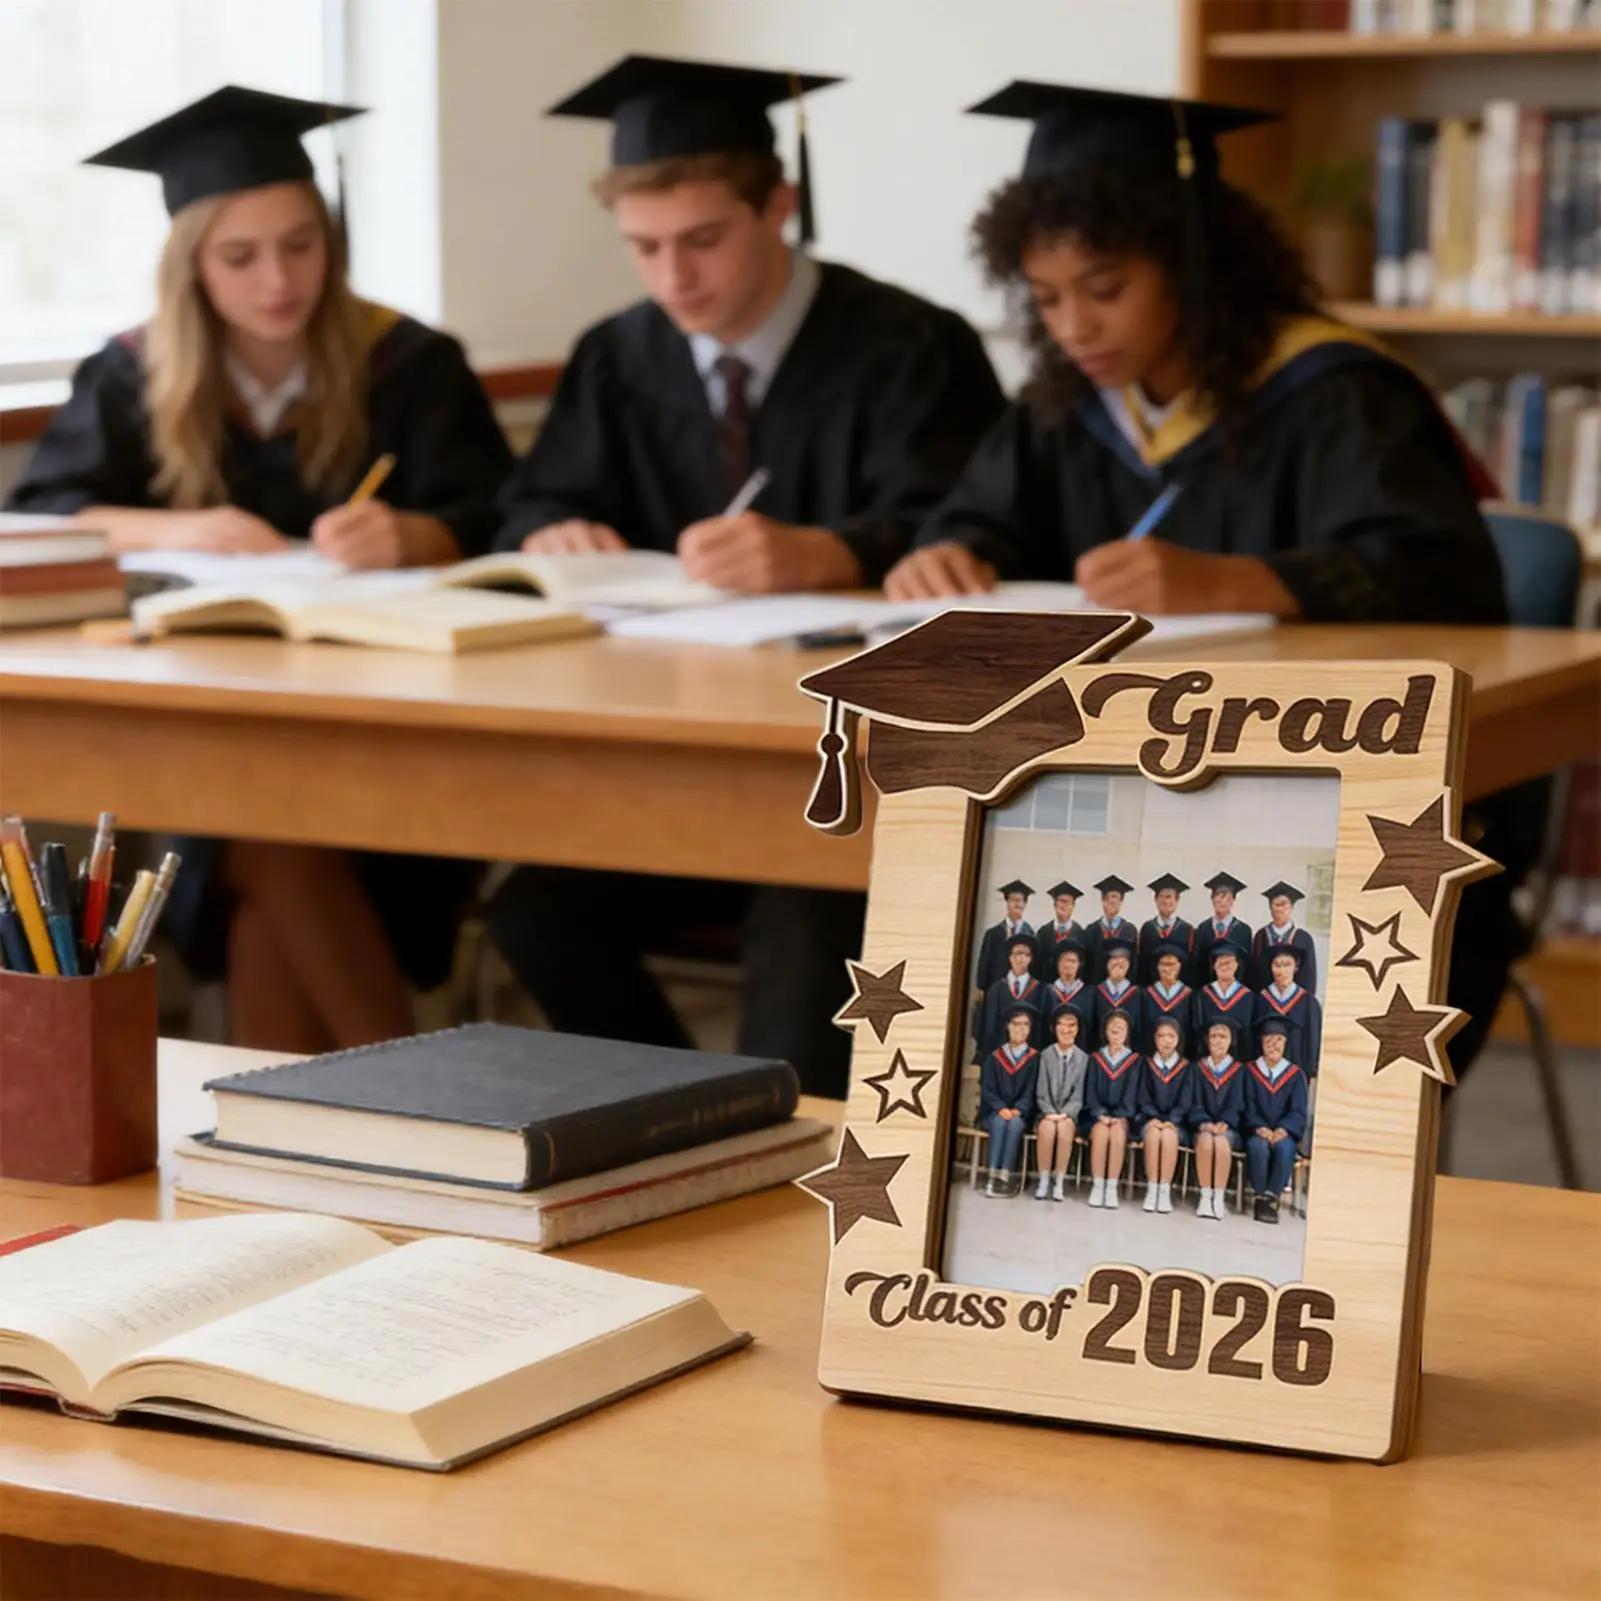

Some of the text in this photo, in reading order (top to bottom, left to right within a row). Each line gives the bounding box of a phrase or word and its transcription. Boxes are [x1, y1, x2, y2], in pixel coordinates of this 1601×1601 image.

[1081, 671, 1435, 776] Grad
[845, 1268, 1335, 1386] Class of 2026
